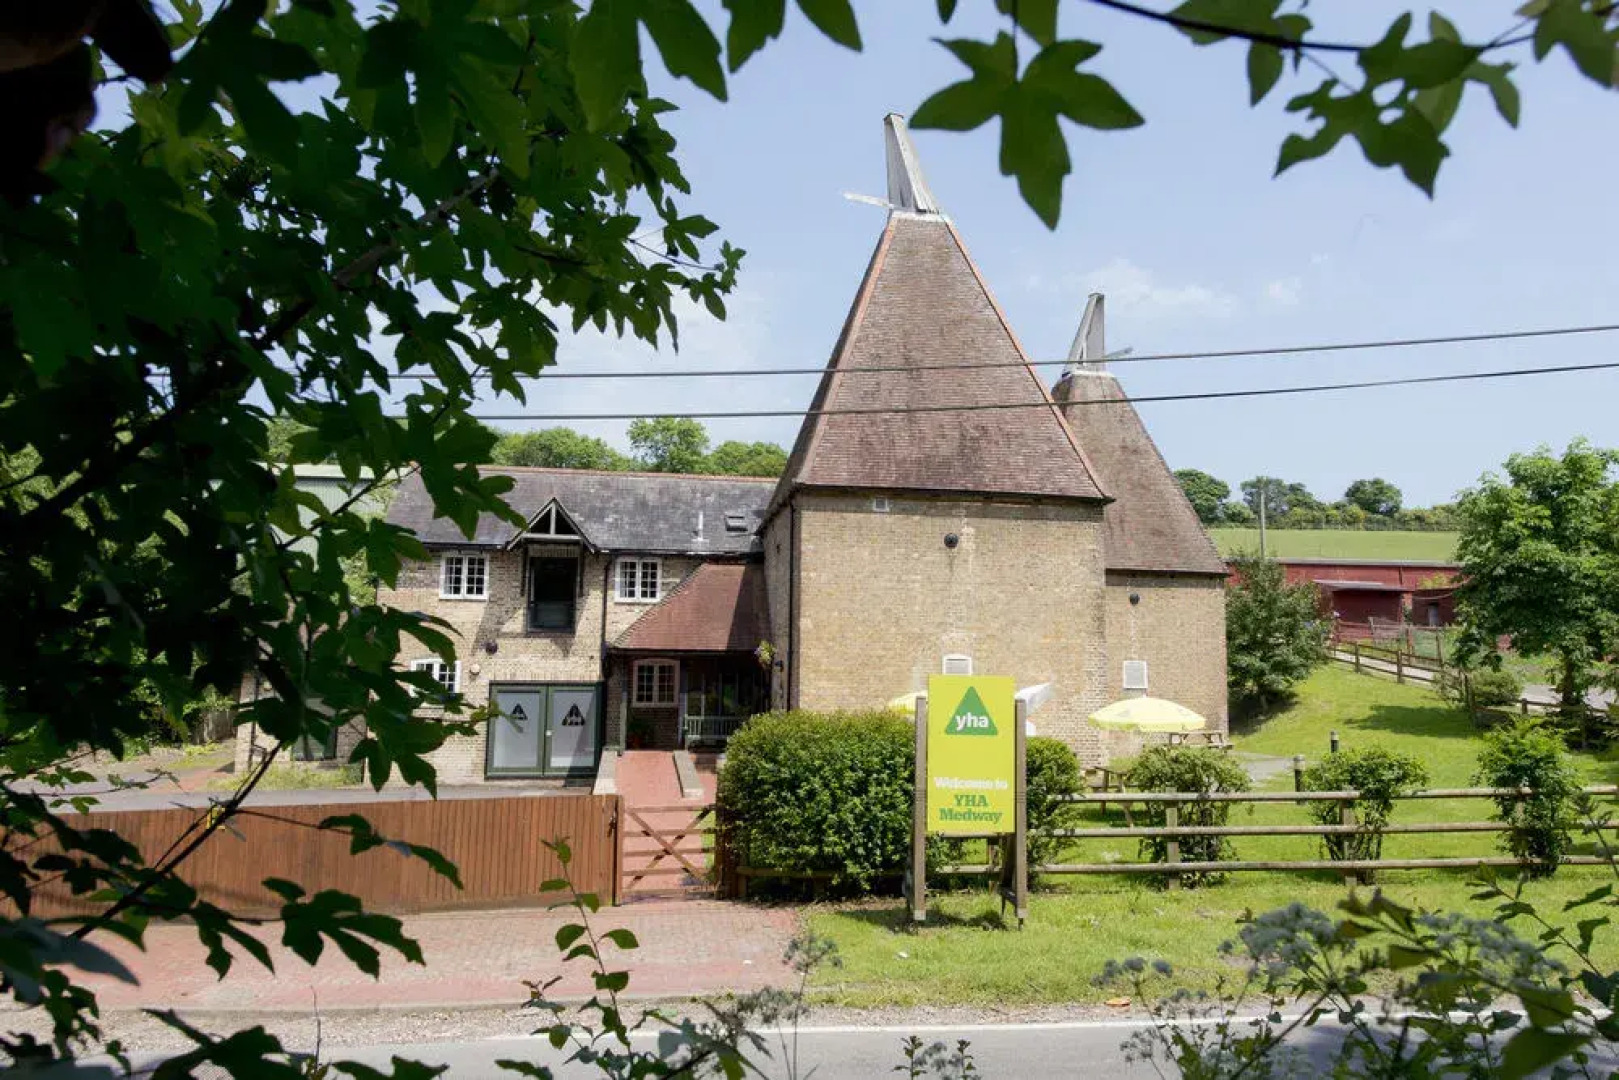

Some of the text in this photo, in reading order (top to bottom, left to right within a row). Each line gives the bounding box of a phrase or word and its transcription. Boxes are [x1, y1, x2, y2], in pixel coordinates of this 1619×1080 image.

[955, 712, 989, 731] yha
[954, 794, 989, 807] YHA
[939, 807, 1003, 825] Medway
